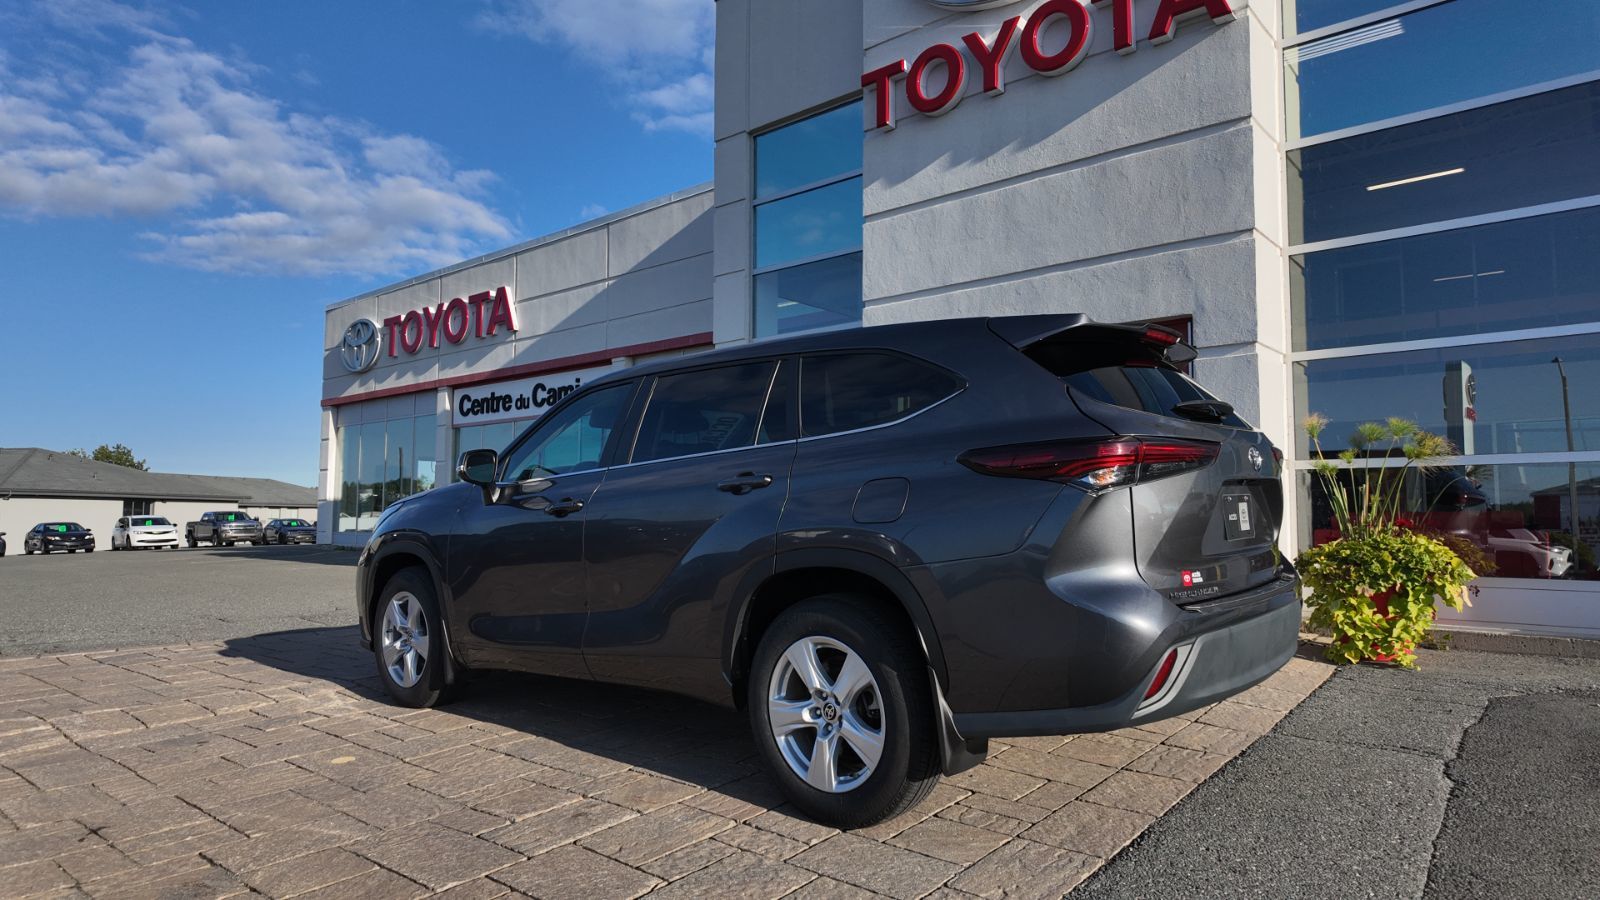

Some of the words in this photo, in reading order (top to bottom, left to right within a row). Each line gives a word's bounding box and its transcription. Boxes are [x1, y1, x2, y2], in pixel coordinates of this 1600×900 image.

[384, 286, 518, 357] TOYOTA
[459, 391, 513, 417] Centre
[515, 393, 530, 410] du
